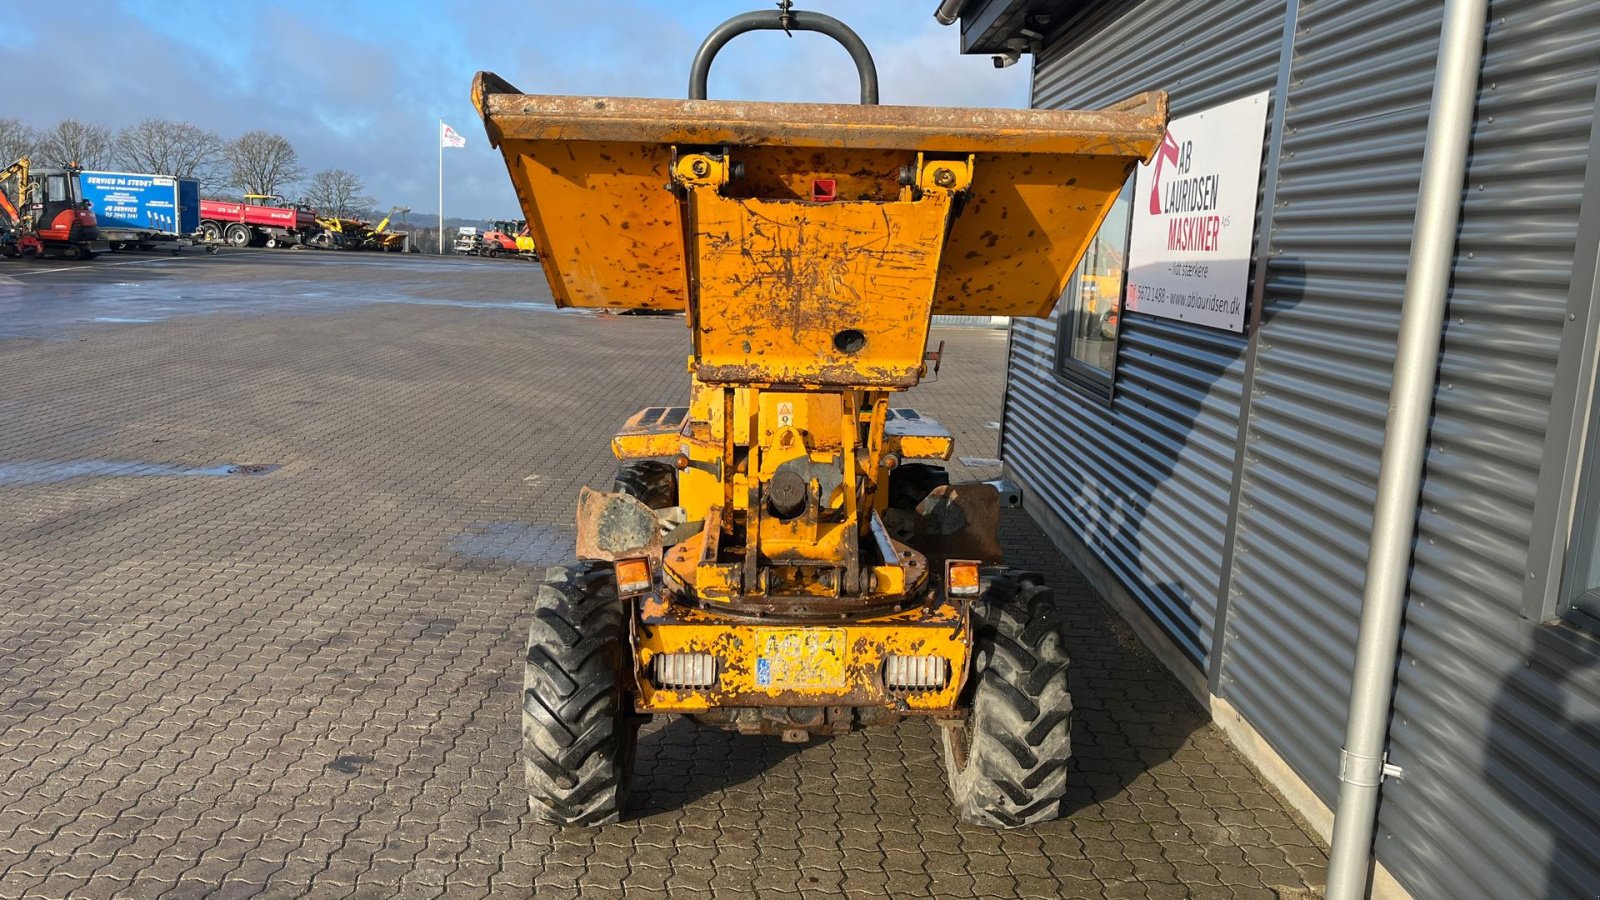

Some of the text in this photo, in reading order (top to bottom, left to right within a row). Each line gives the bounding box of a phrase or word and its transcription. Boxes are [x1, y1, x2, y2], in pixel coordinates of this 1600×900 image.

[1178, 140, 1192, 175] AB
[87, 177, 116, 185] SERVICE
[117, 177, 126, 185] PÅ
[127, 179, 153, 187] STEDET
[1164, 174, 1219, 214] LAURIDSEN
[1167, 215, 1220, 251] MASKINER
[1181, 261, 1209, 279] stærkere
[1170, 292, 1241, 315] www.ablauridsen.dk
